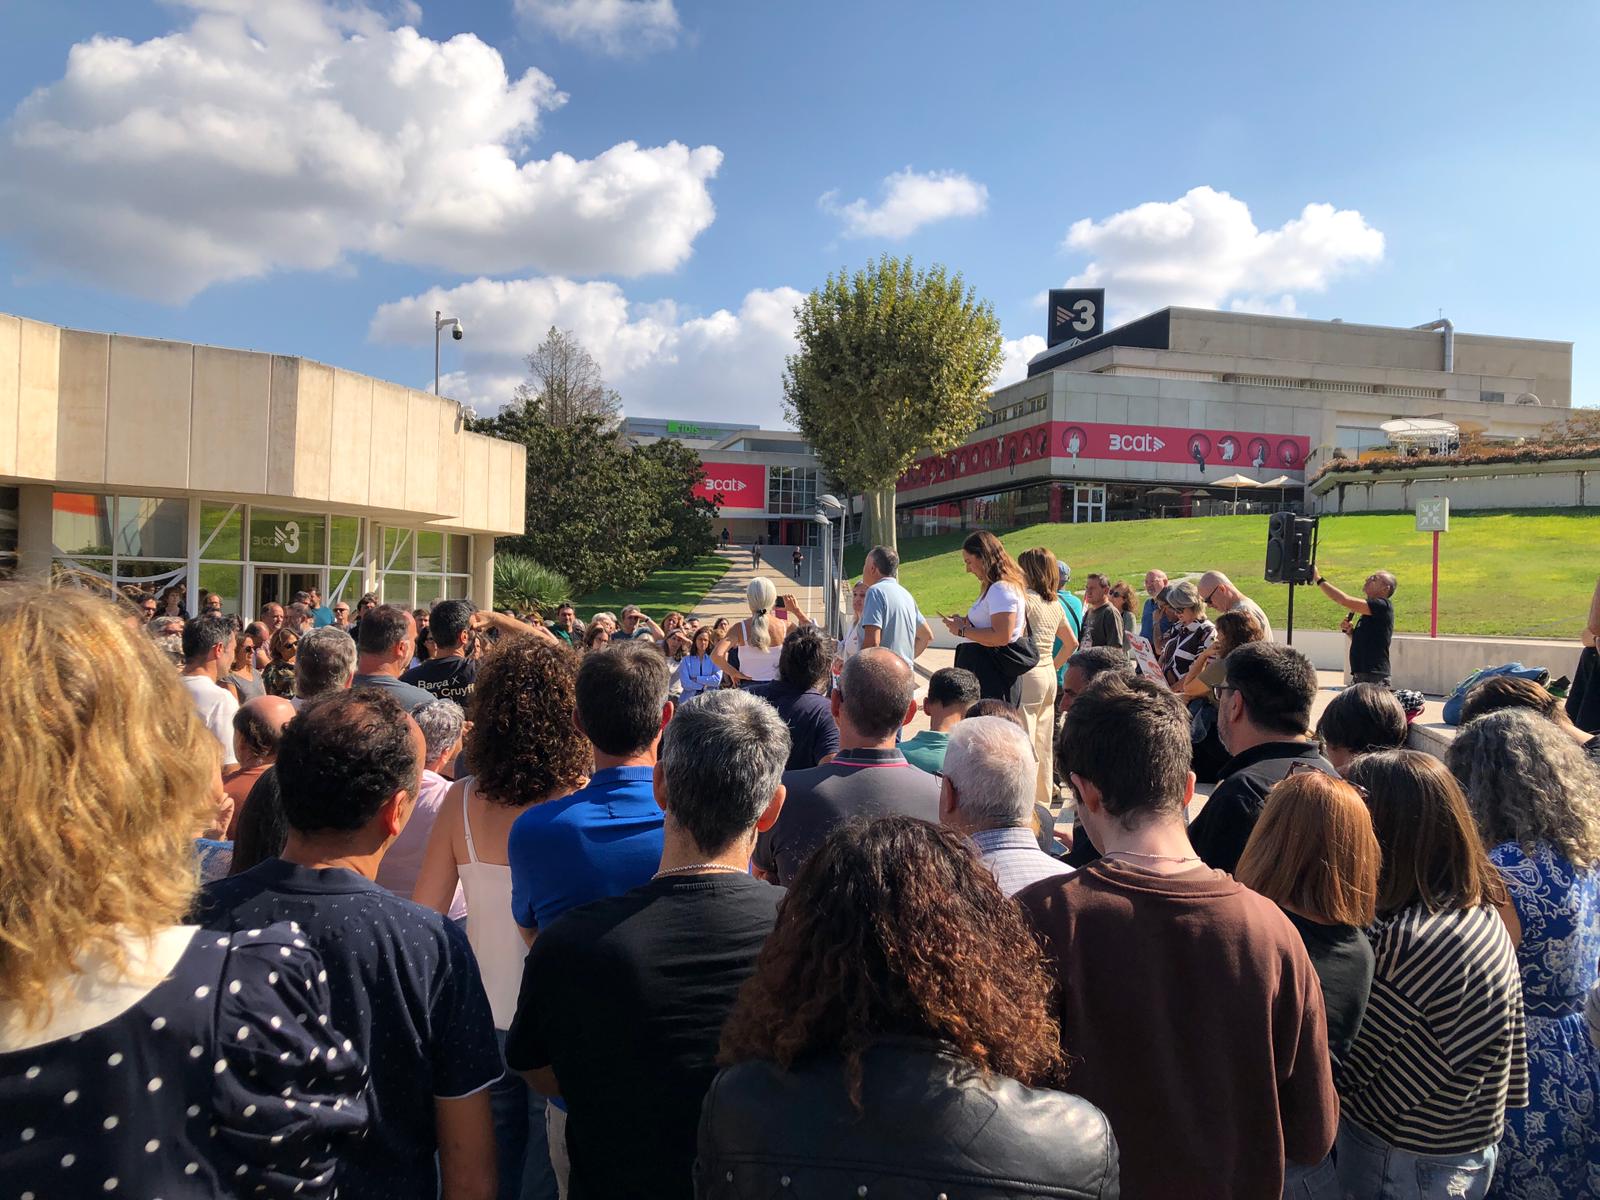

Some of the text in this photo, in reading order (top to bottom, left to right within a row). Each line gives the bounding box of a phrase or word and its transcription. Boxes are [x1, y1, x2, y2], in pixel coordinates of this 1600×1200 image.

[1072, 299, 1096, 332] 3
[1109, 432, 1153, 452] 3cat
[705, 478, 737, 492] 3cat
[417, 680, 449, 690] Barça
[441, 683, 475, 697] Cruyff
